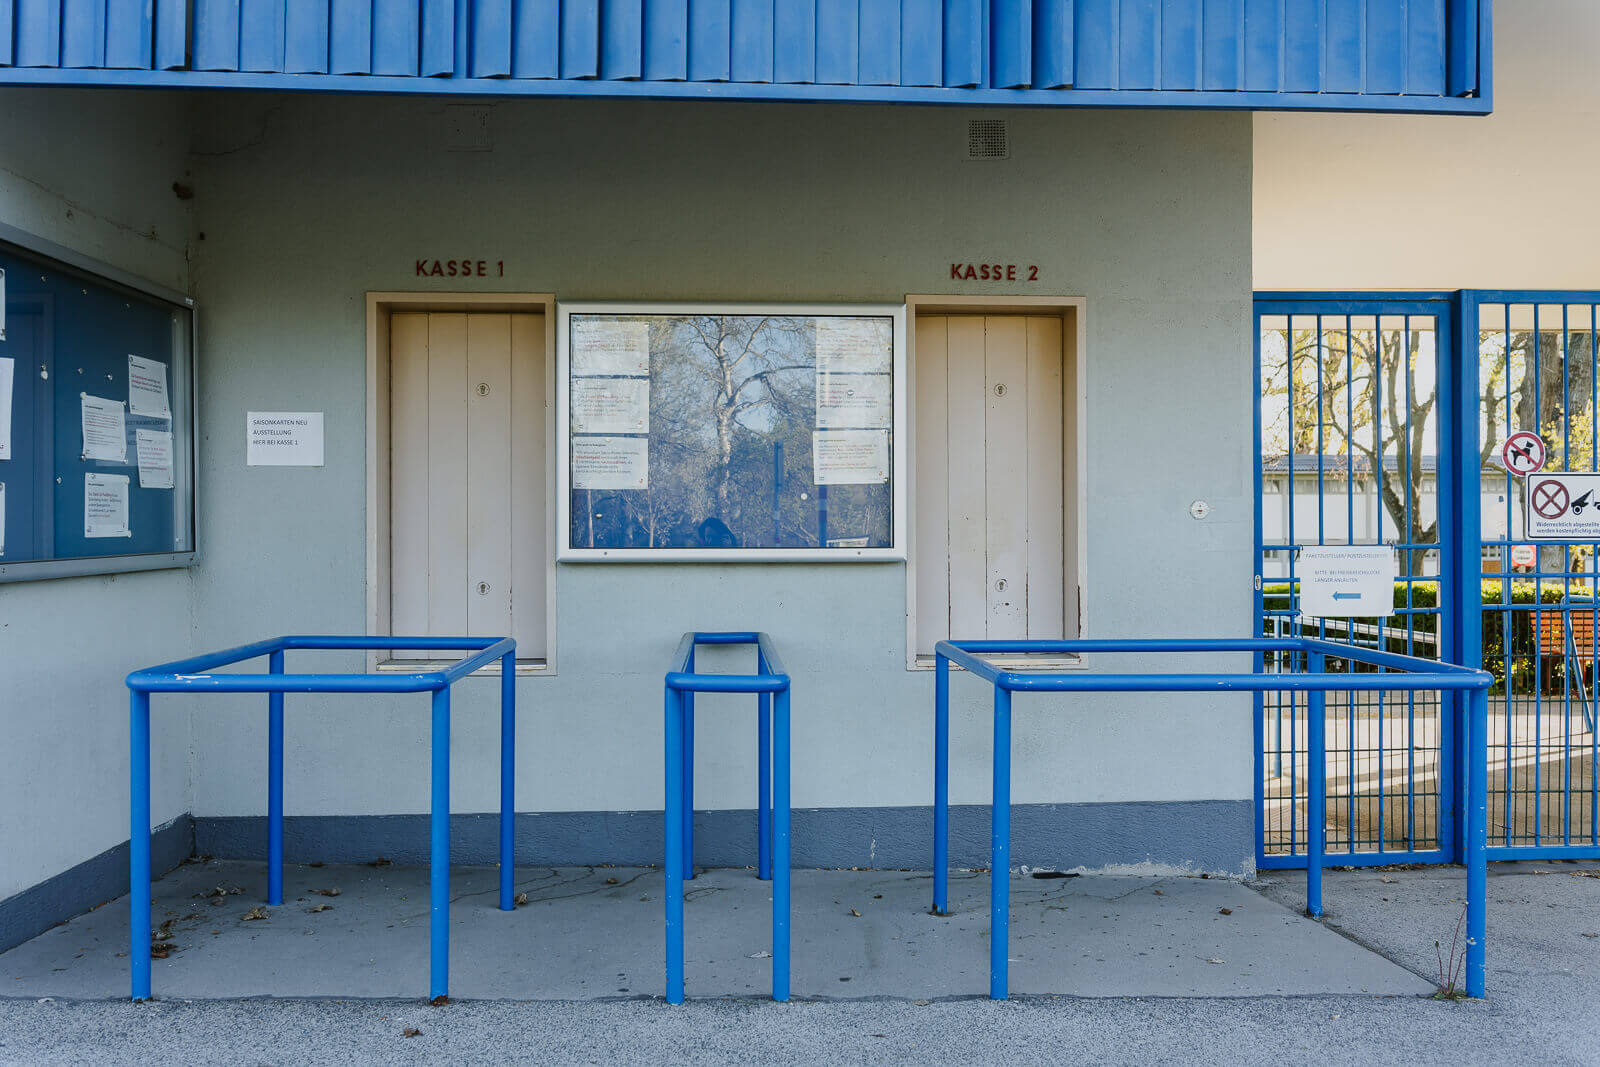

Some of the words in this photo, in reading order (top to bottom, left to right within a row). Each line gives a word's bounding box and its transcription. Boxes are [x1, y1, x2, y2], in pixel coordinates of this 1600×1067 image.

[416, 260, 487, 277] KASSE
[497, 260, 504, 277] 1
[951, 263, 1016, 281] KASSE
[1027, 265, 1039, 281] 2
[1556, 527, 1592, 535] kostenpflichtig
[1573, 521, 1600, 529] abgestellte
